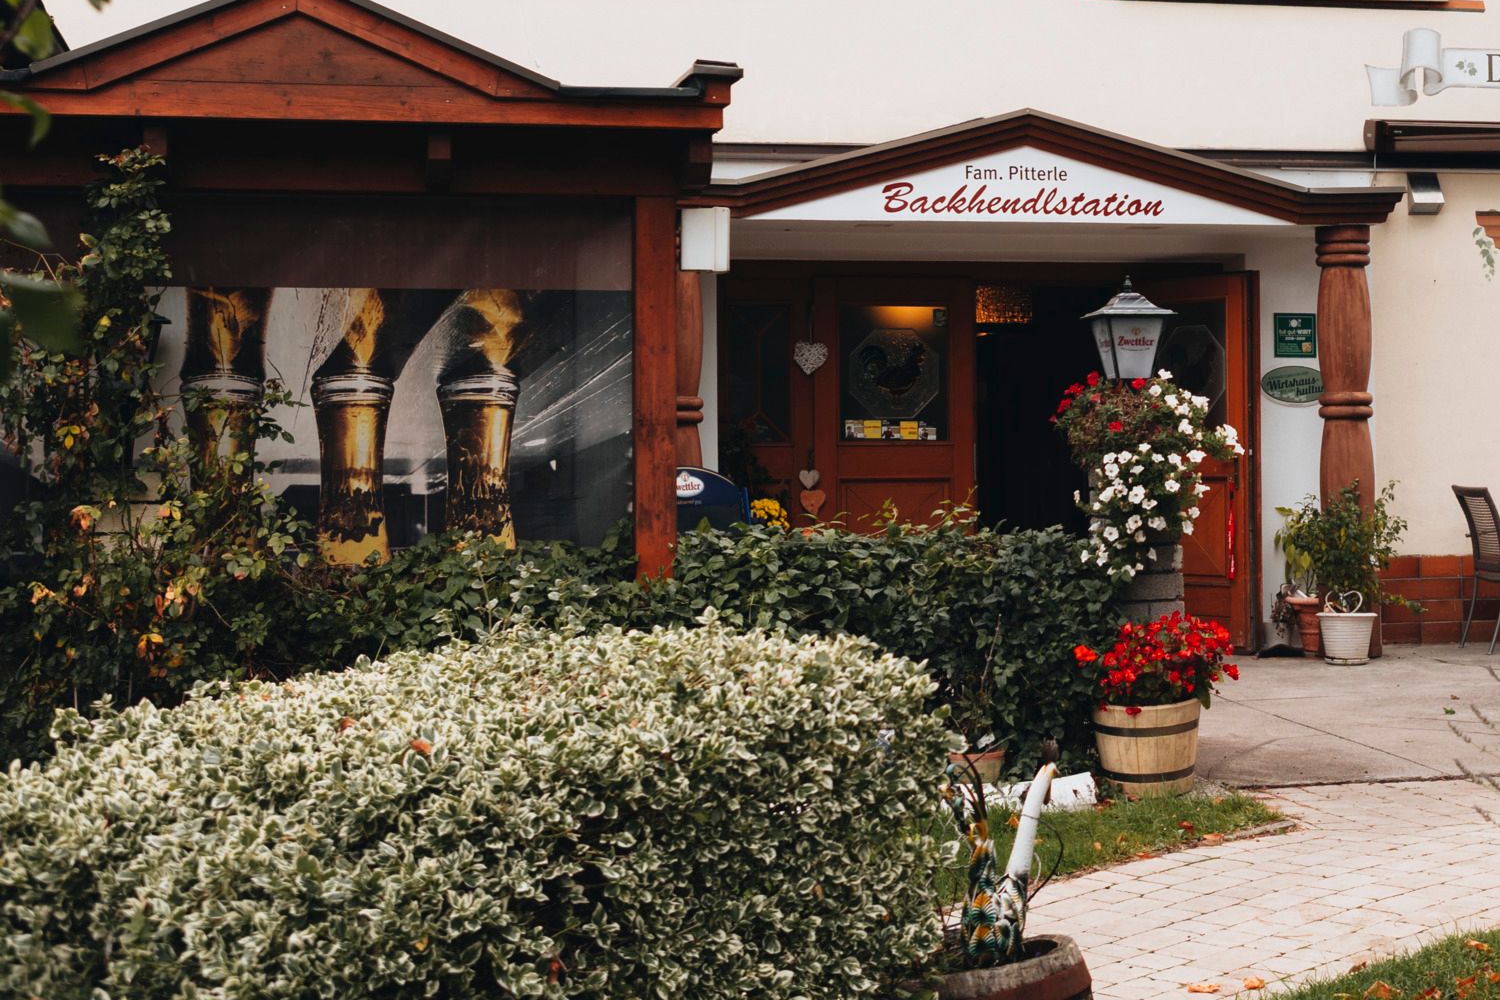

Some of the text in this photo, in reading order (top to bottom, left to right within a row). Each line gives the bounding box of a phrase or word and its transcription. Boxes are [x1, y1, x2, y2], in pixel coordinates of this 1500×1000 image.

[965, 165, 1068, 181] Fam. Pitterle
[881, 181, 1165, 217] Backhendlstation
[1117, 335, 1155, 347] Zwettler
